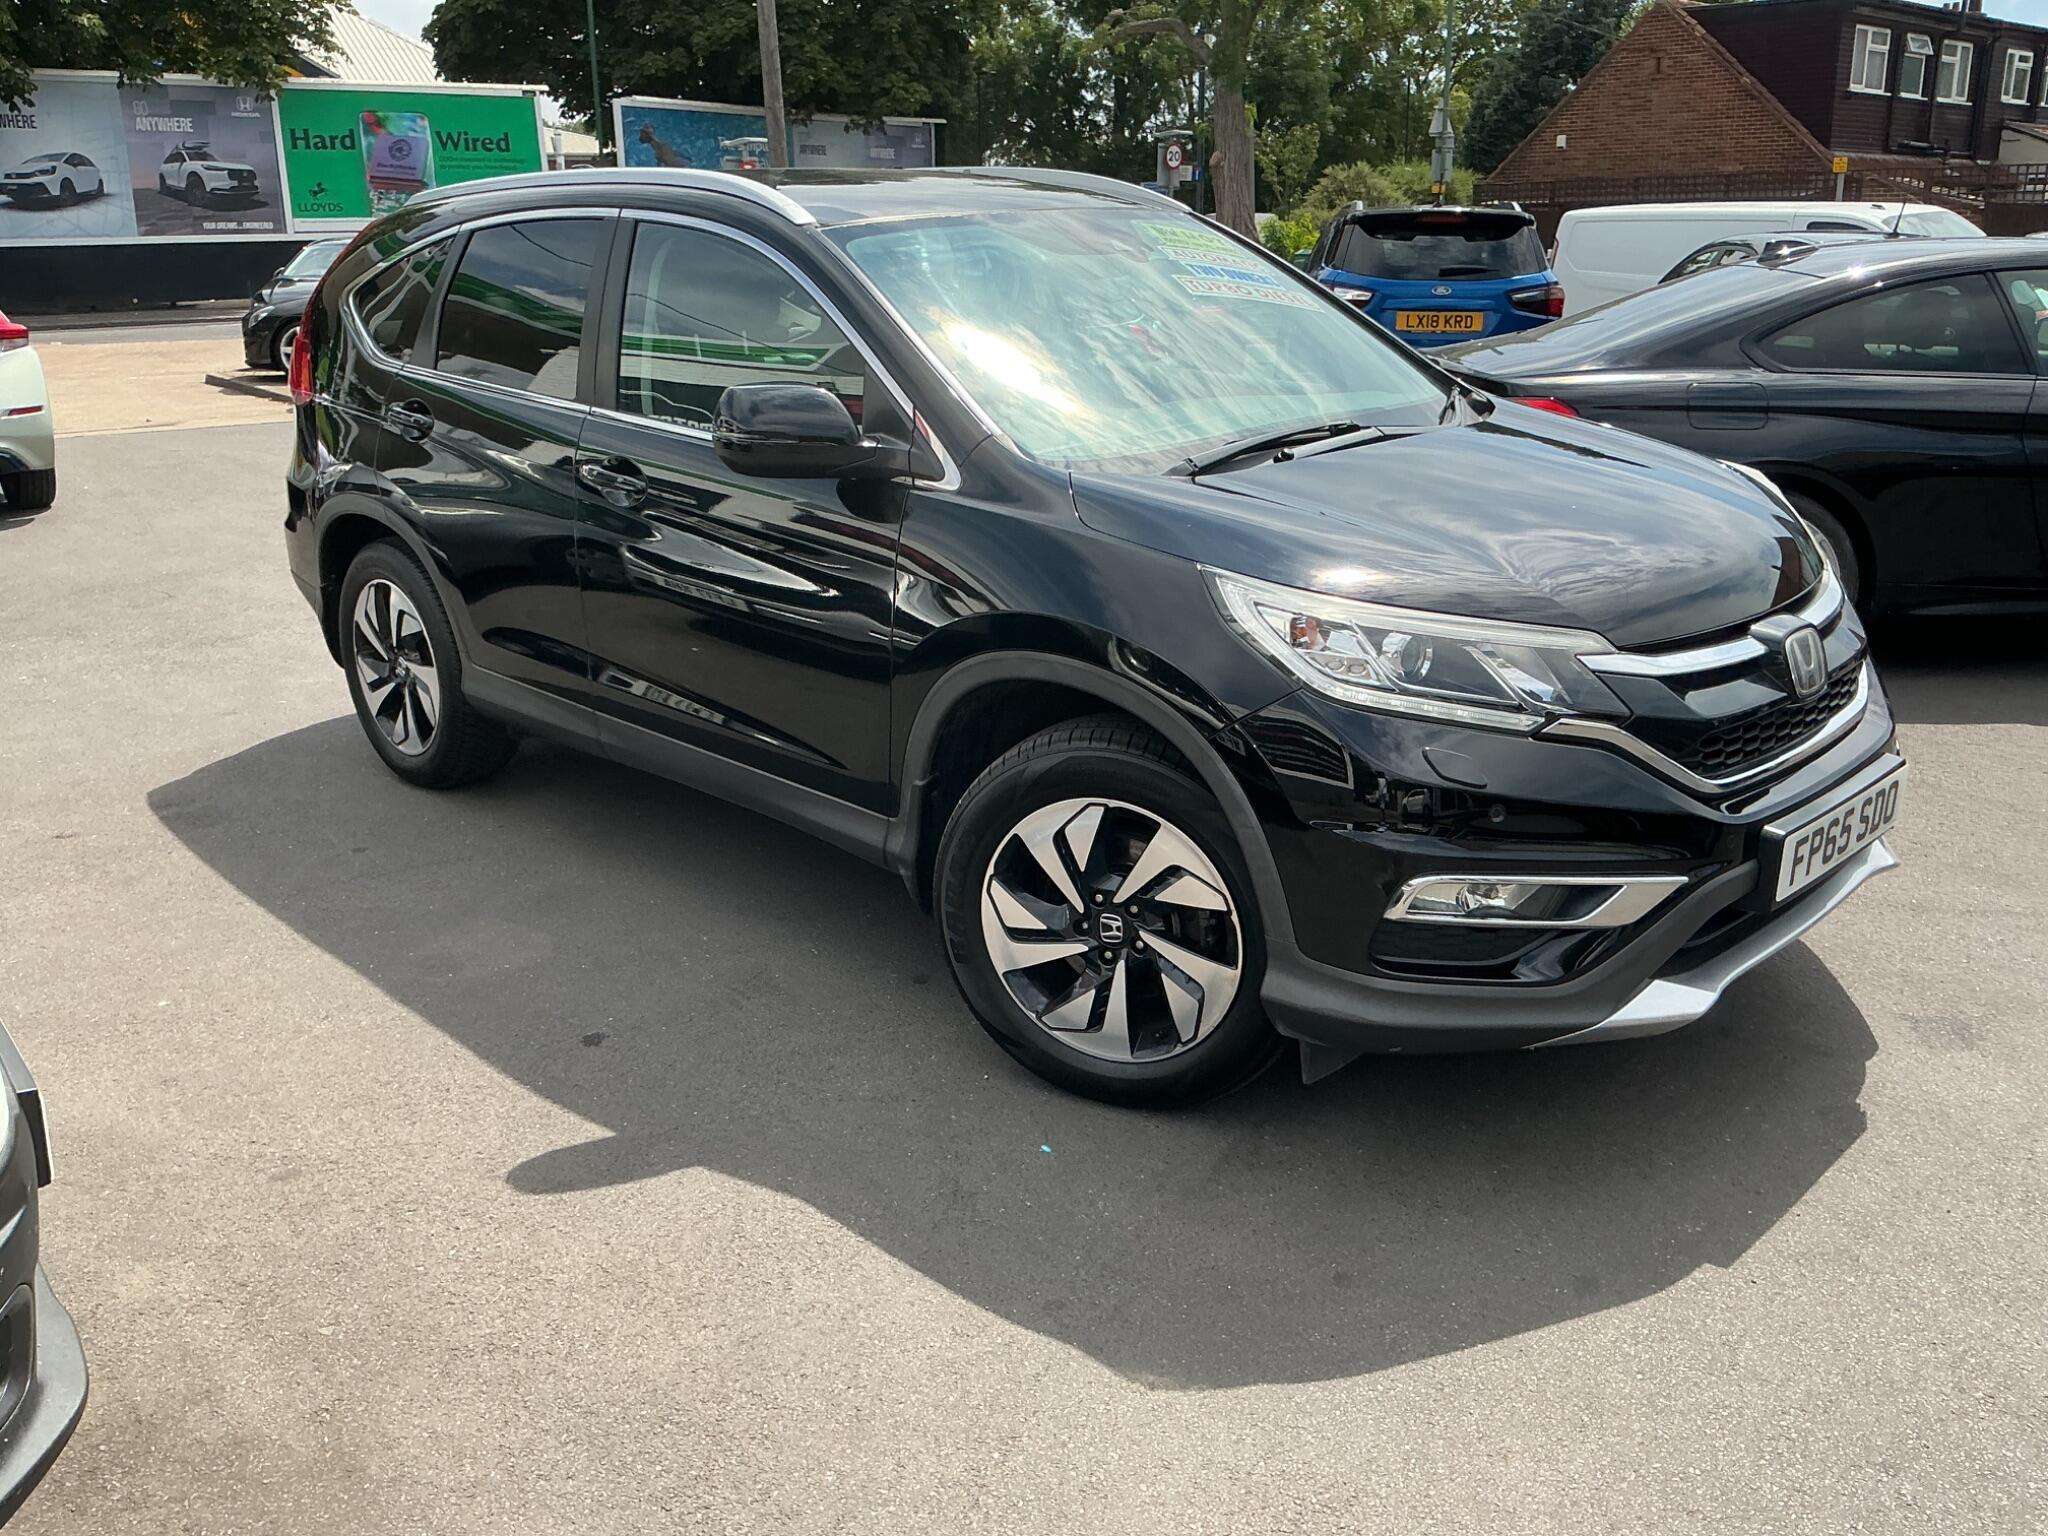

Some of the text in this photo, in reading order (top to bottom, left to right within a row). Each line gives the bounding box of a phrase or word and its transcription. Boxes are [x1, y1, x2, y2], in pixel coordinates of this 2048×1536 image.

[135, 116, 194, 133] ANYWHERE
[289, 128, 511, 153] Hard Wired
[1168, 150, 1180, 162] 20
[298, 202, 344, 213] LLOYDS
[1406, 313, 1474, 329] LX18 KRD
[1788, 779, 1900, 887] FP65 SDO
